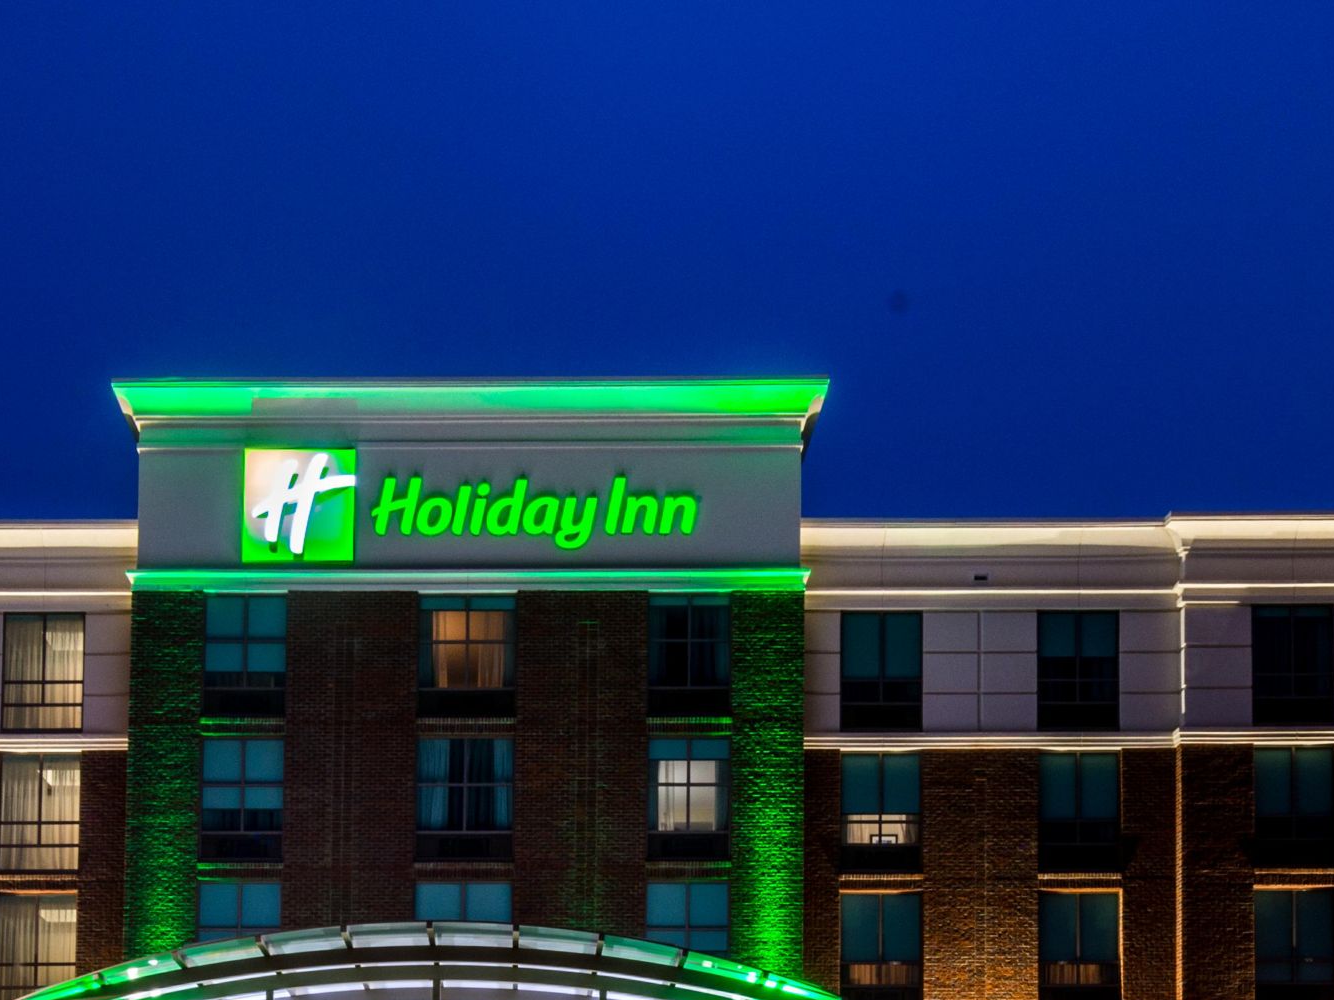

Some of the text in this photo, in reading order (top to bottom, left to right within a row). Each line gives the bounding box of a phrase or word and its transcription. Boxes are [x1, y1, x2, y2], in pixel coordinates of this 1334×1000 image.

[252, 453, 355, 554] H
[371, 477, 697, 549] Holiday Inn
